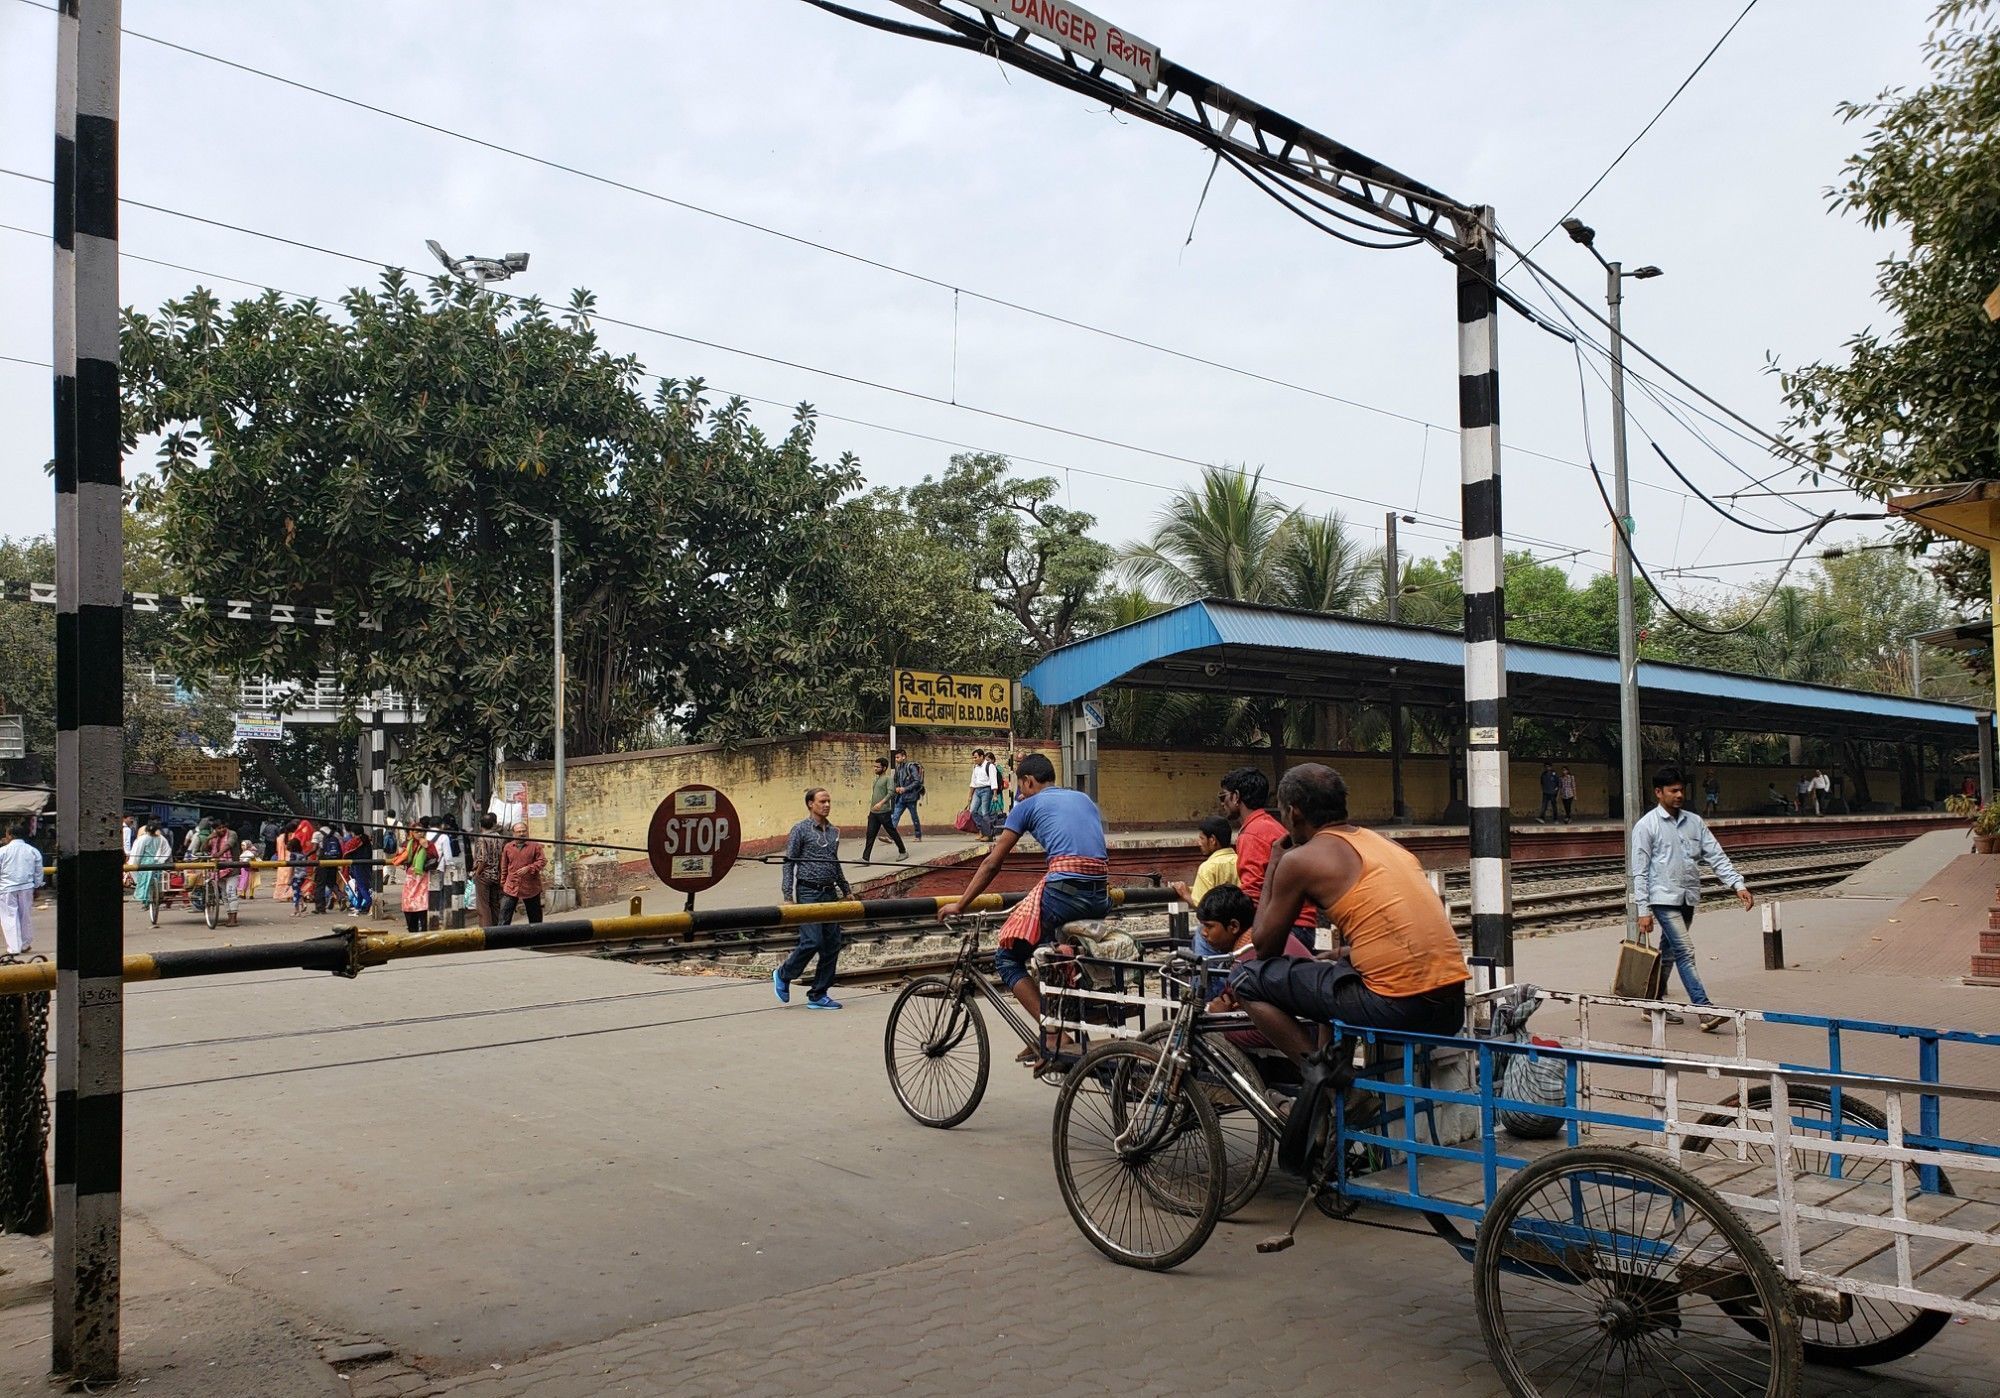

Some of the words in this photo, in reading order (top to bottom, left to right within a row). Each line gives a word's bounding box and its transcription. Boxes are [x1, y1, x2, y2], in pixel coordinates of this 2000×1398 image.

[1011, 0, 1097, 49] DANGER
[1106, 27, 1151, 74] বিপদ
[664, 817, 730, 855] STOP
